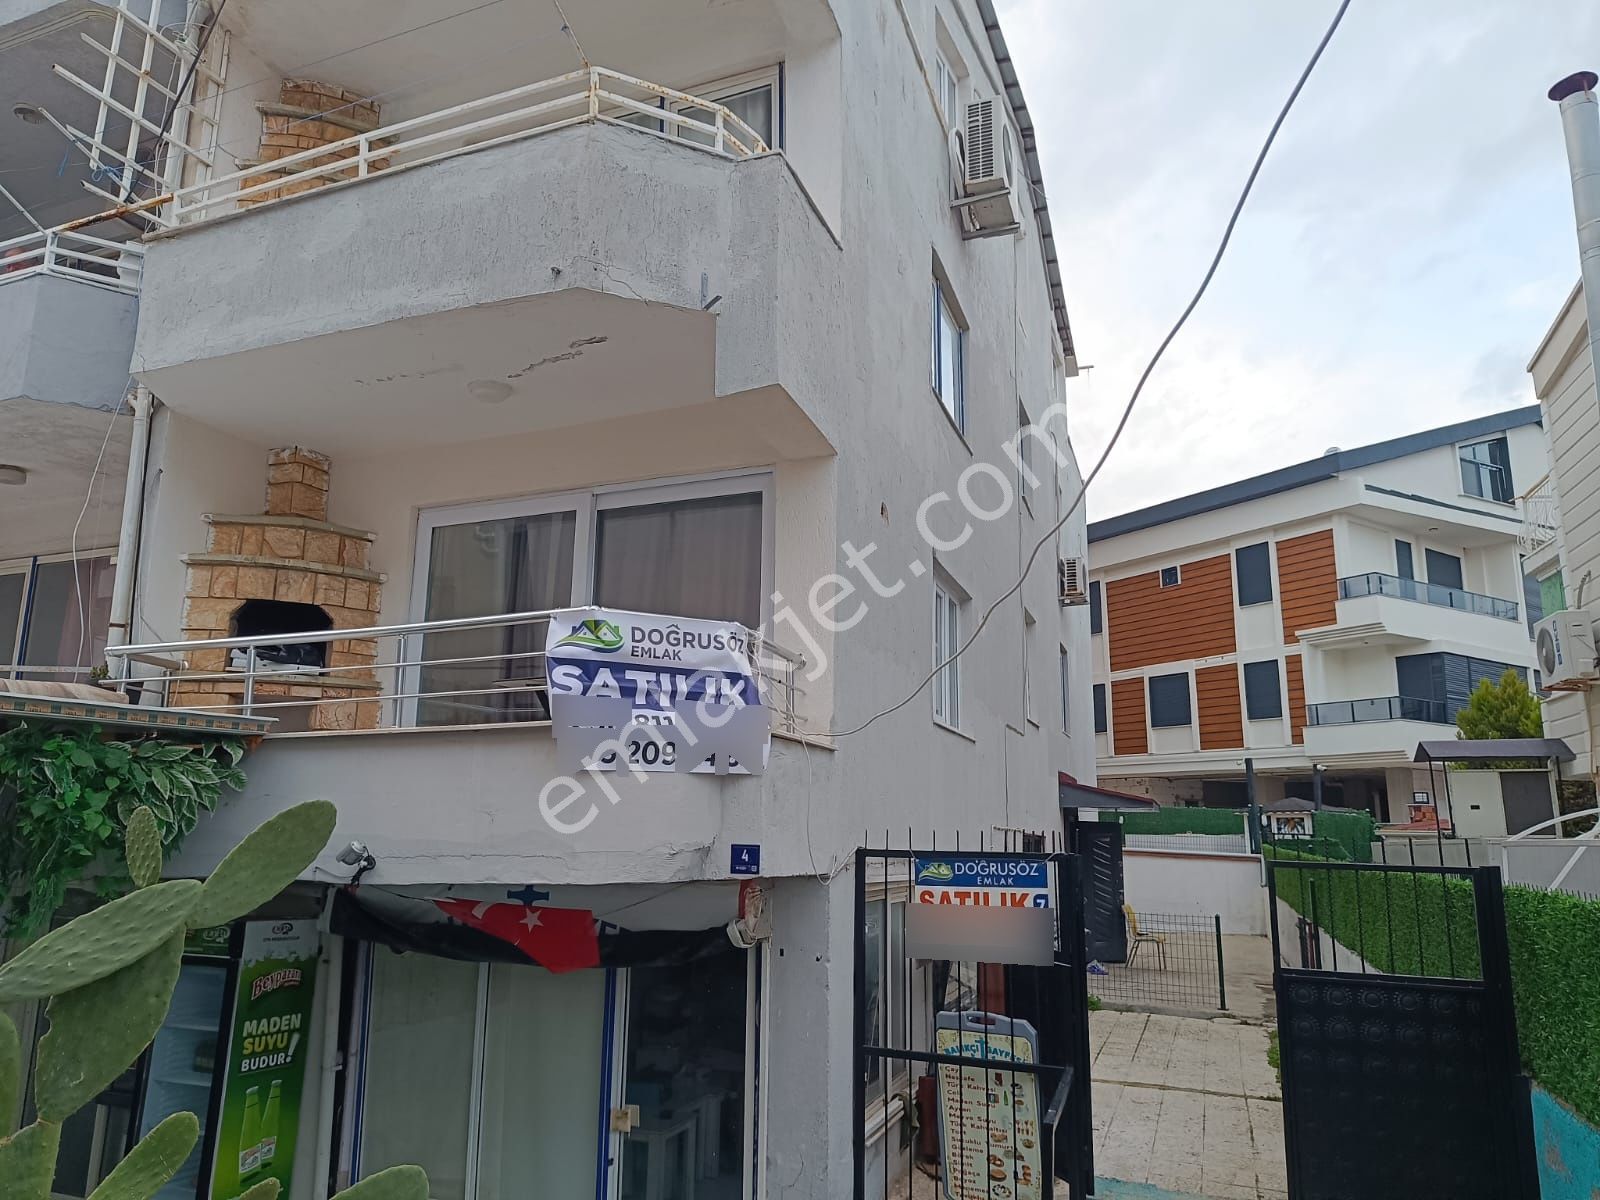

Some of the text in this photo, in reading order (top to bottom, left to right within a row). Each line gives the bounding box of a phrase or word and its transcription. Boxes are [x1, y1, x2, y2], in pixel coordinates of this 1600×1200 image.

[631, 624, 744, 654] DOĞRUSÖZ
[631, 646, 682, 661] EMLAK
[741, 849, 749, 862] 4
[954, 860, 1039, 876] DOĞRUSÖZ
[977, 877, 1014, 886] EMLAK
[242, 1013, 302, 1037] MADEN
[242, 1032, 288, 1055] SUYU
[241, 1032, 300, 1072] BUDUR!
[945, 1074, 975, 1082] Nesafe
[967, 1084, 996, 1092] Kahvsi
[949, 1105, 971, 1113] Ayan
[952, 1136, 982, 1146] Suuklu
